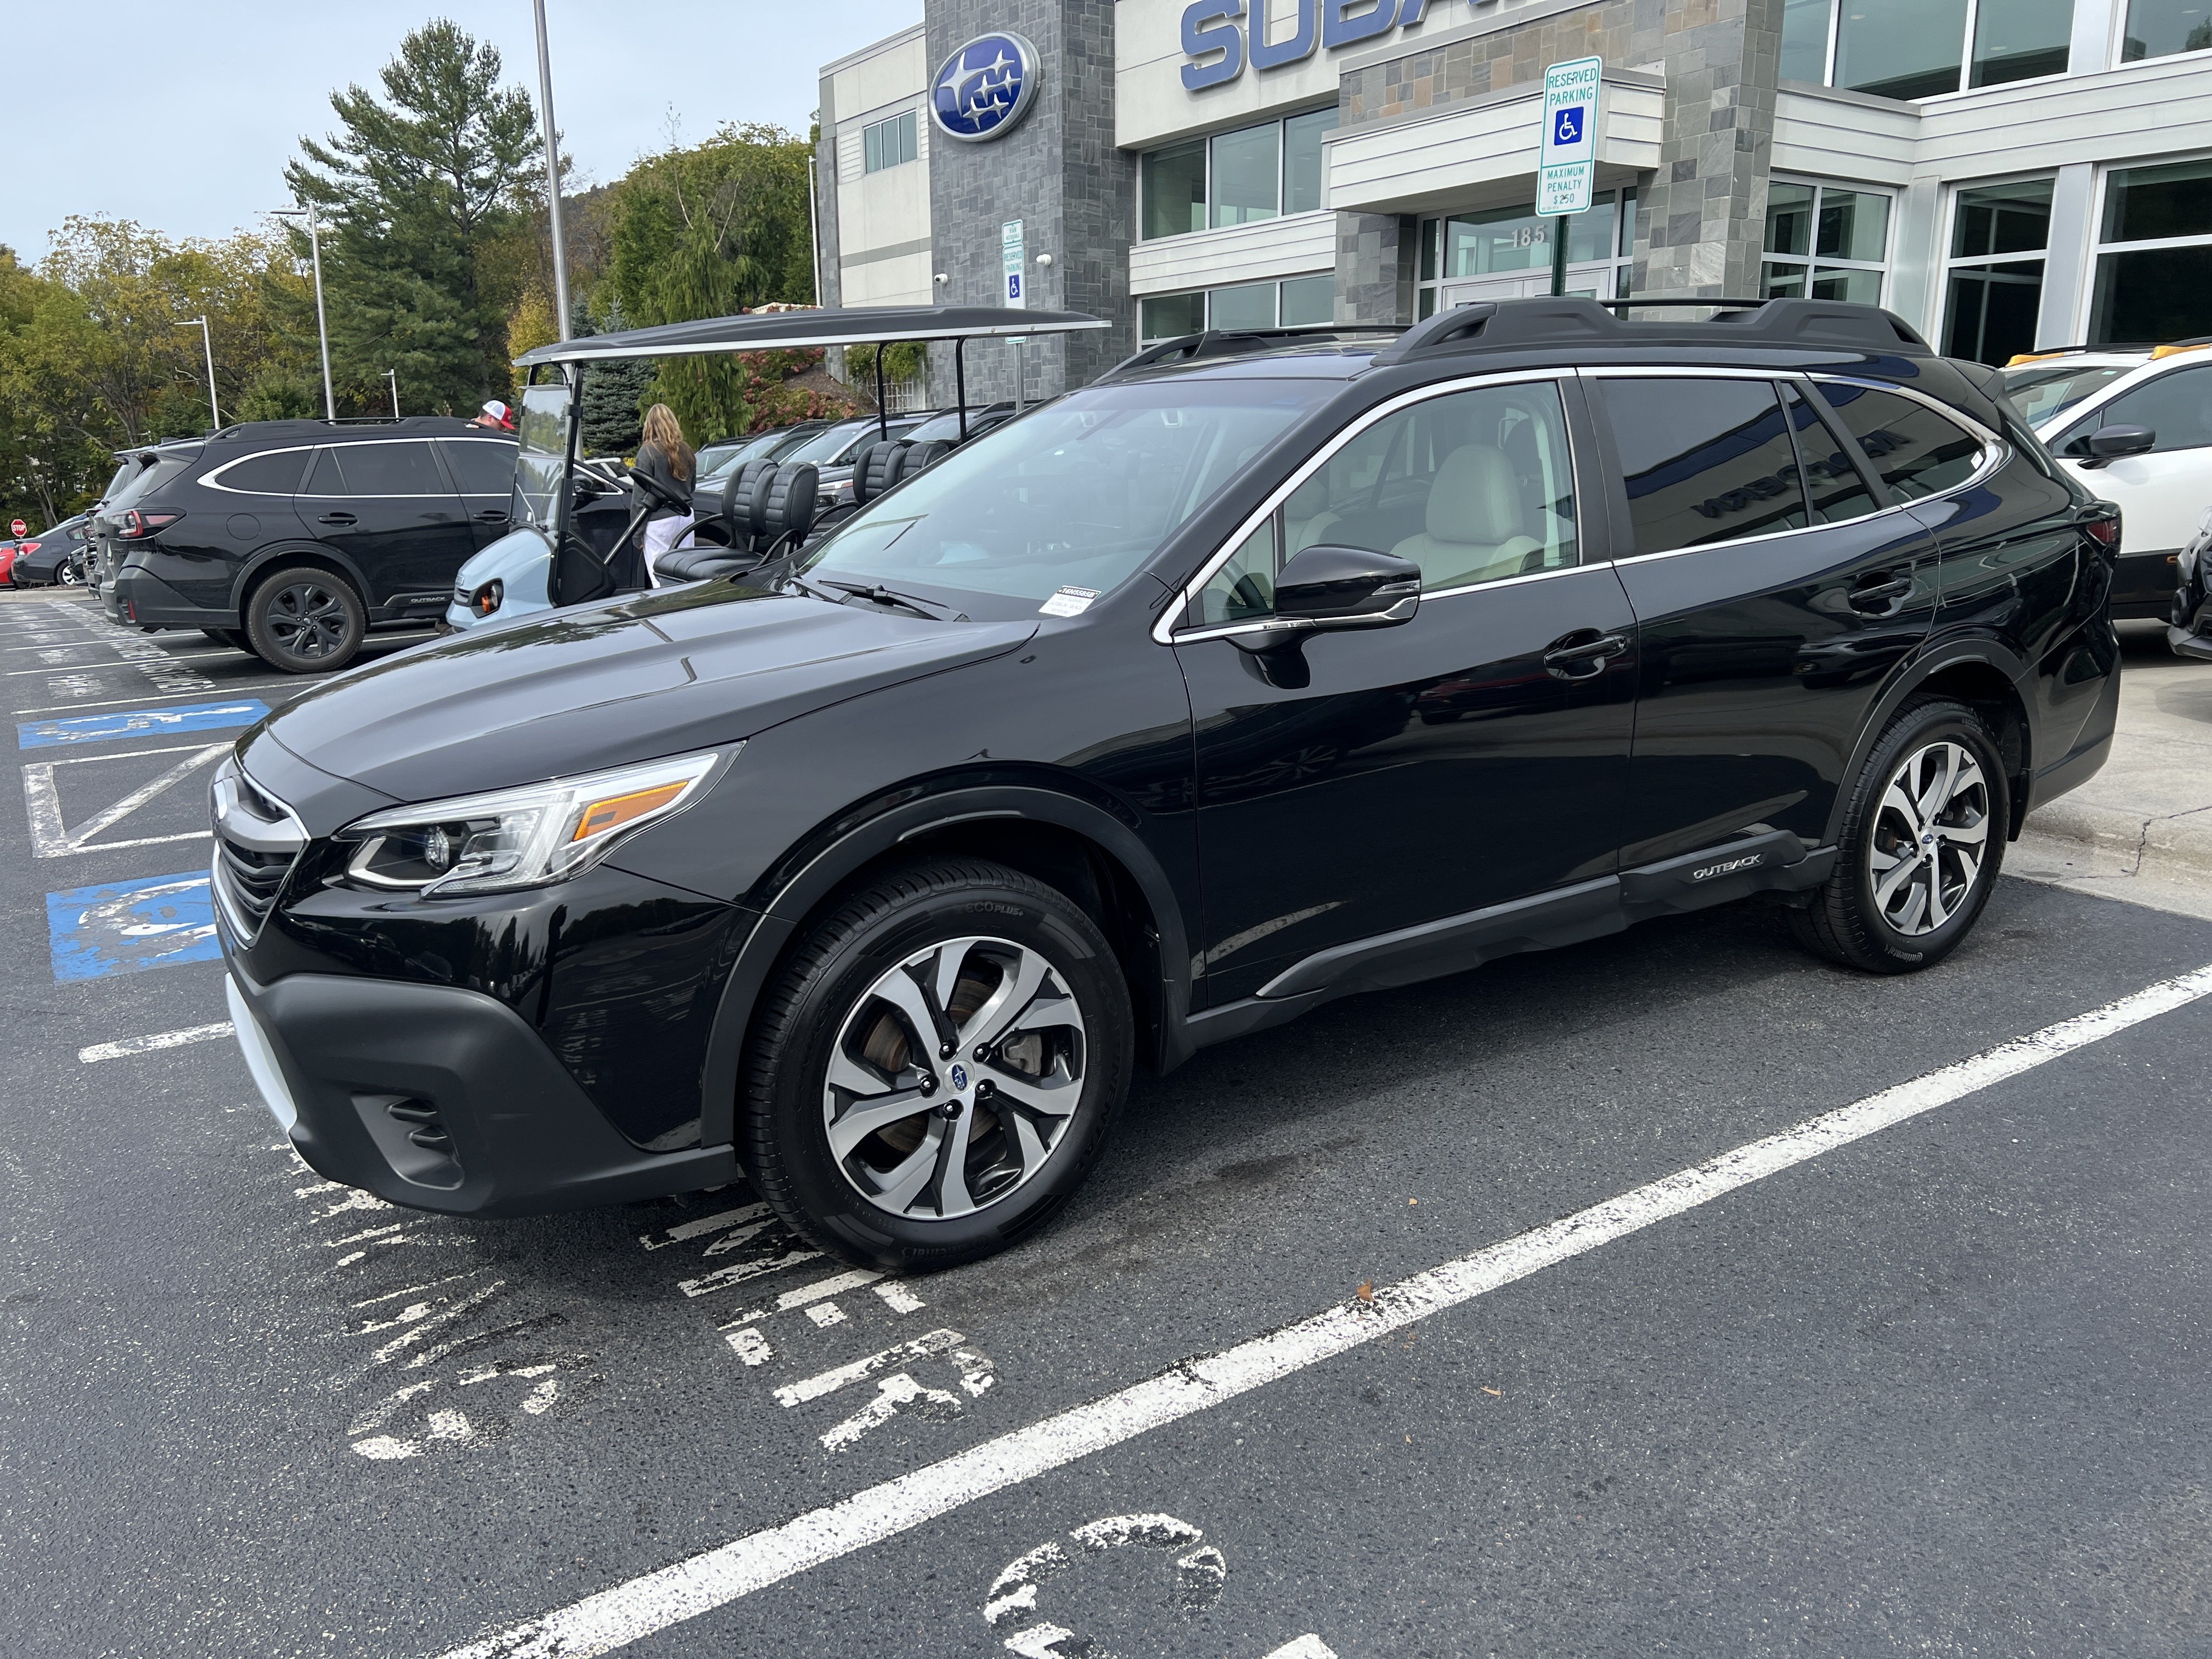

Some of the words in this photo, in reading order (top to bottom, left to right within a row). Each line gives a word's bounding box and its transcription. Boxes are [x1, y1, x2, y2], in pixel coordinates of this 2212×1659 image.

[1548, 68, 1596, 88] RESERVED
[1549, 86, 1593, 106] PARKING
[1547, 166, 1584, 179] MAXIMUM
[1547, 179, 1582, 193] PENALTY
[1511, 224, 1545, 248] 185
[1005, 251, 1022, 261] RESERVED
[1006, 262, 1022, 272] PARKING
[1694, 853, 1761, 879] OUTBACK
[1887, 946, 1923, 963] Continental
